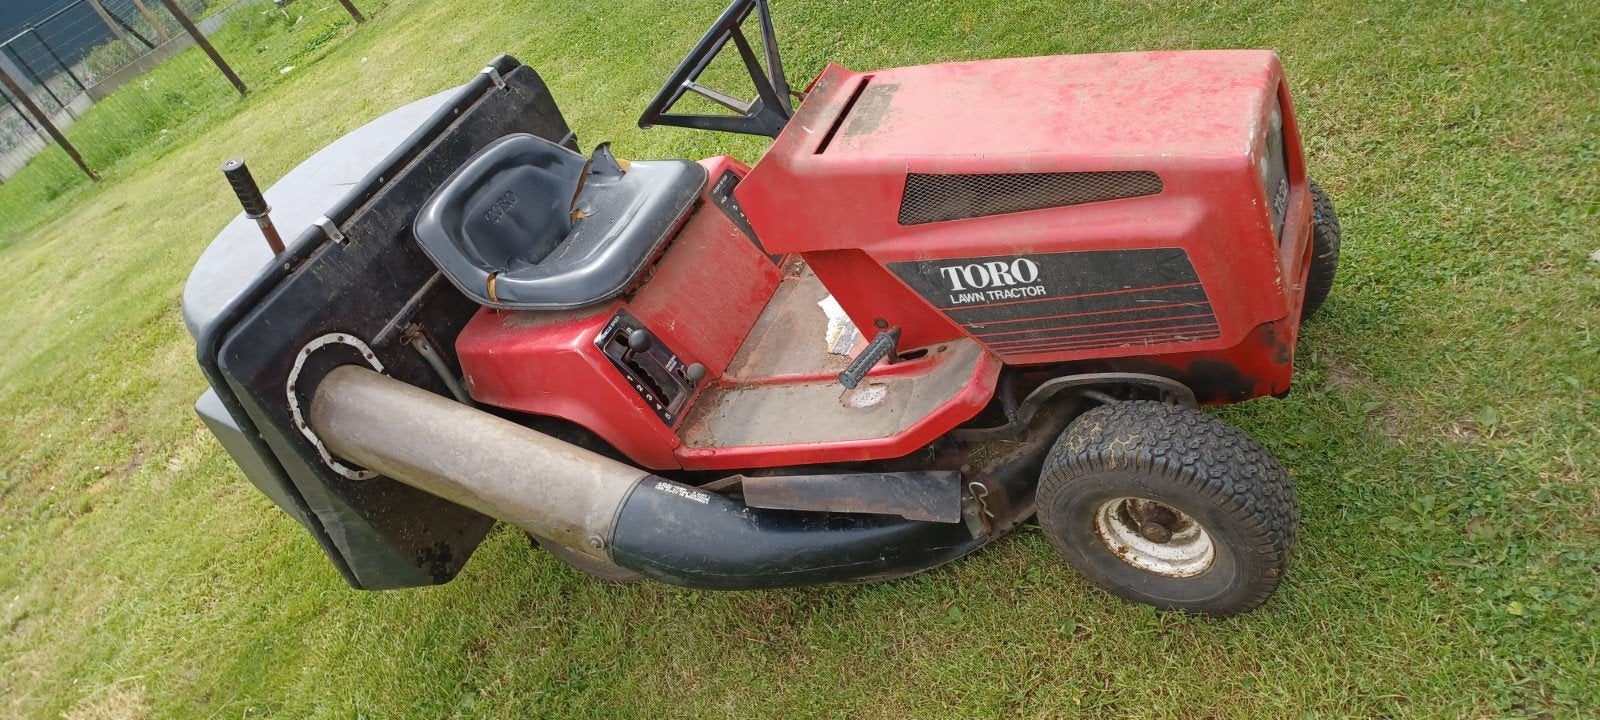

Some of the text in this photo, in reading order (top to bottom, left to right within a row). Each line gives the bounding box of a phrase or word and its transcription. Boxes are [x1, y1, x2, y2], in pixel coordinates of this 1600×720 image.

[940, 258, 1038, 291] TORO
[950, 285, 1046, 304] LAWN TRACTOR
[636, 384, 643, 392] 2
[664, 412, 671, 420] 5
